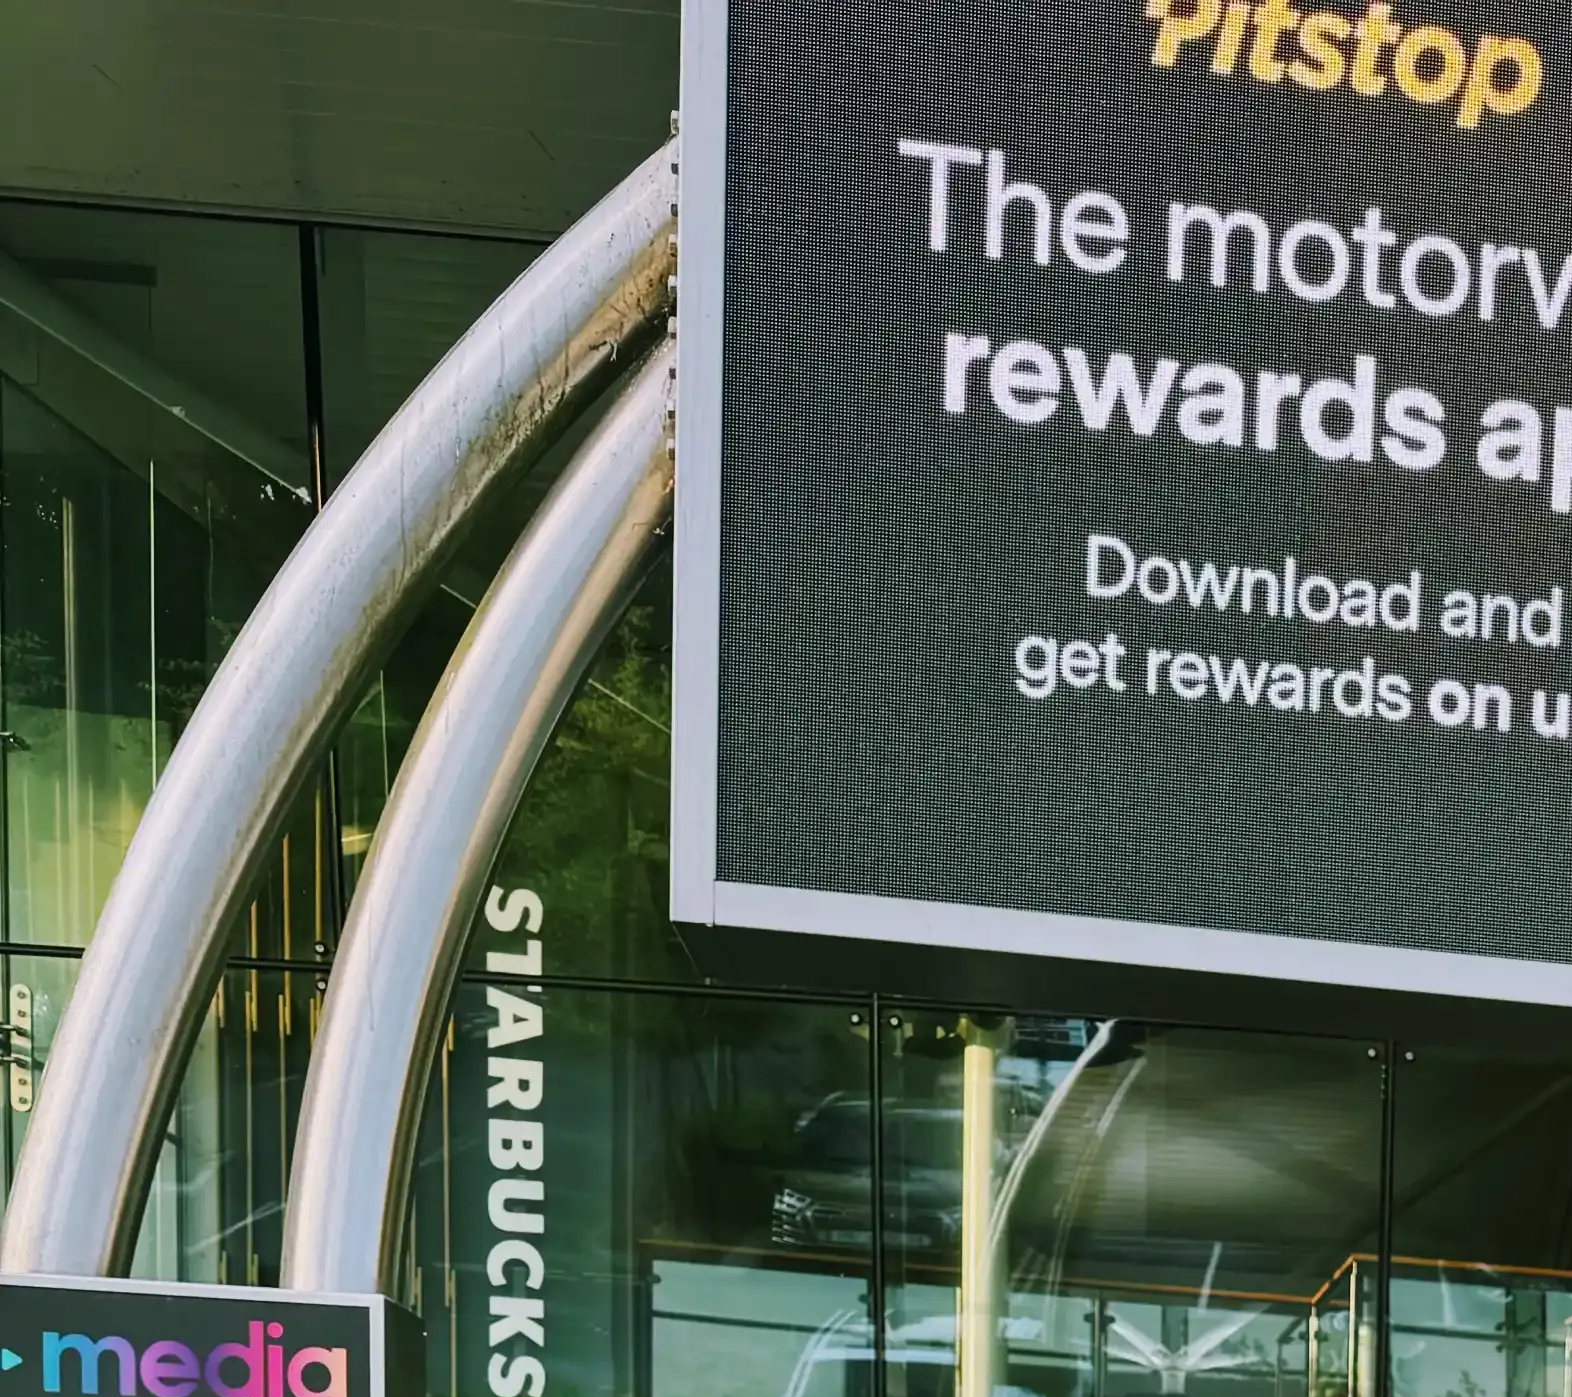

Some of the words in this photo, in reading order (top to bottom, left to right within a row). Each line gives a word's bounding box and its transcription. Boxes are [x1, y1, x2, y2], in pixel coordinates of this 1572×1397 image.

[897, 140, 1130, 273] The
[942, 329, 1445, 470] rewards
[1086, 534, 1421, 631] Download
[1441, 587, 1564, 648] and
[1014, 633, 1127, 699] get
[1147, 646, 1412, 720] rewards
[1428, 678, 1511, 732] on
